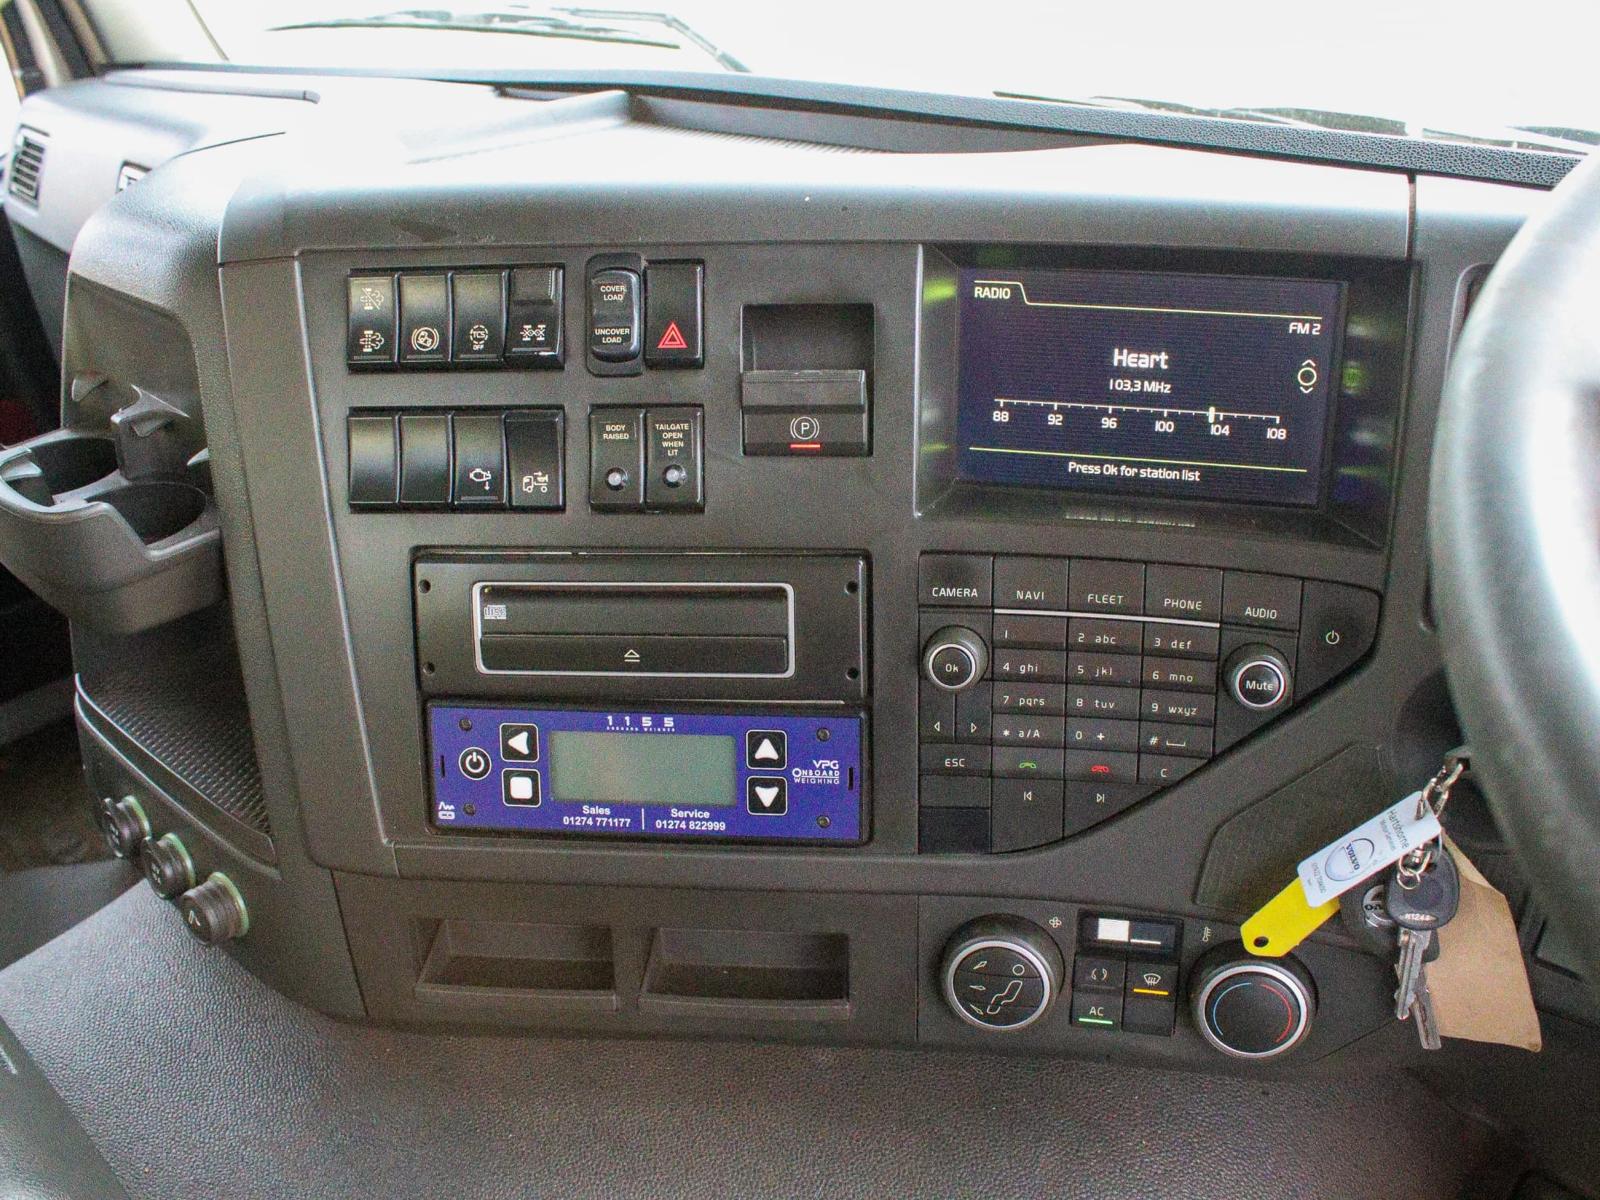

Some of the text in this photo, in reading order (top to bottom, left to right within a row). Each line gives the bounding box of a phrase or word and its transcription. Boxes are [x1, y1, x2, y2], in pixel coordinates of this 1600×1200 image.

[600, 285, 627, 293] COVER
[974, 286, 1011, 299] RADIO
[595, 328, 630, 336] UNCOVER
[1289, 322, 1321, 335] FM 2
[472, 330, 486, 339] TCS
[602, 336, 622, 344] LOAD
[1113, 348, 1169, 370] Heart
[1109, 378, 1172, 394] 103,3 MHz
[605, 424, 626, 432] BODY
[655, 423, 689, 431] TAILGATE
[992, 410, 1287, 440] 88 92 96 100 104 108
[667, 449, 678, 457] LIT
[1068, 461, 1200, 481] Press Ok for station list
[932, 587, 978, 598] CAMERA
[1016, 590, 1044, 600] NAVI
[1087, 593, 1124, 605] FLEET
[1164, 598, 1202, 611] PHONE
[1244, 606, 1277, 619] AUDIO
[1078, 633, 1116, 645] 2 abc
[1154, 638, 1192, 650] 3 def
[945, 663, 959, 673] Ok
[1002, 662, 1039, 674] 4 ghi
[1077, 665, 1113, 677] 5 jkl
[1152, 670, 1193, 682] 6 mno
[1245, 680, 1274, 691] Mute
[1003, 695, 1045, 707] 7 pqrs
[1076, 698, 1116, 709] 8 tuv
[1151, 702, 1197, 717] 9 wxyz
[1018, 729, 1041, 738] a/A
[812, 760, 839, 770] VPG
[944, 758, 966, 768] ESC
[1160, 768, 1168, 778] C
[793, 777, 840, 785] WEIGHING
[582, 805, 611, 815] Sales
[671, 809, 710, 819] Service
[563, 816, 631, 828] 01274 771177
[655, 820, 726, 831] 01274 822999
[1346, 842, 1361, 871] VOLVO
[1089, 1006, 1105, 1016] AC
